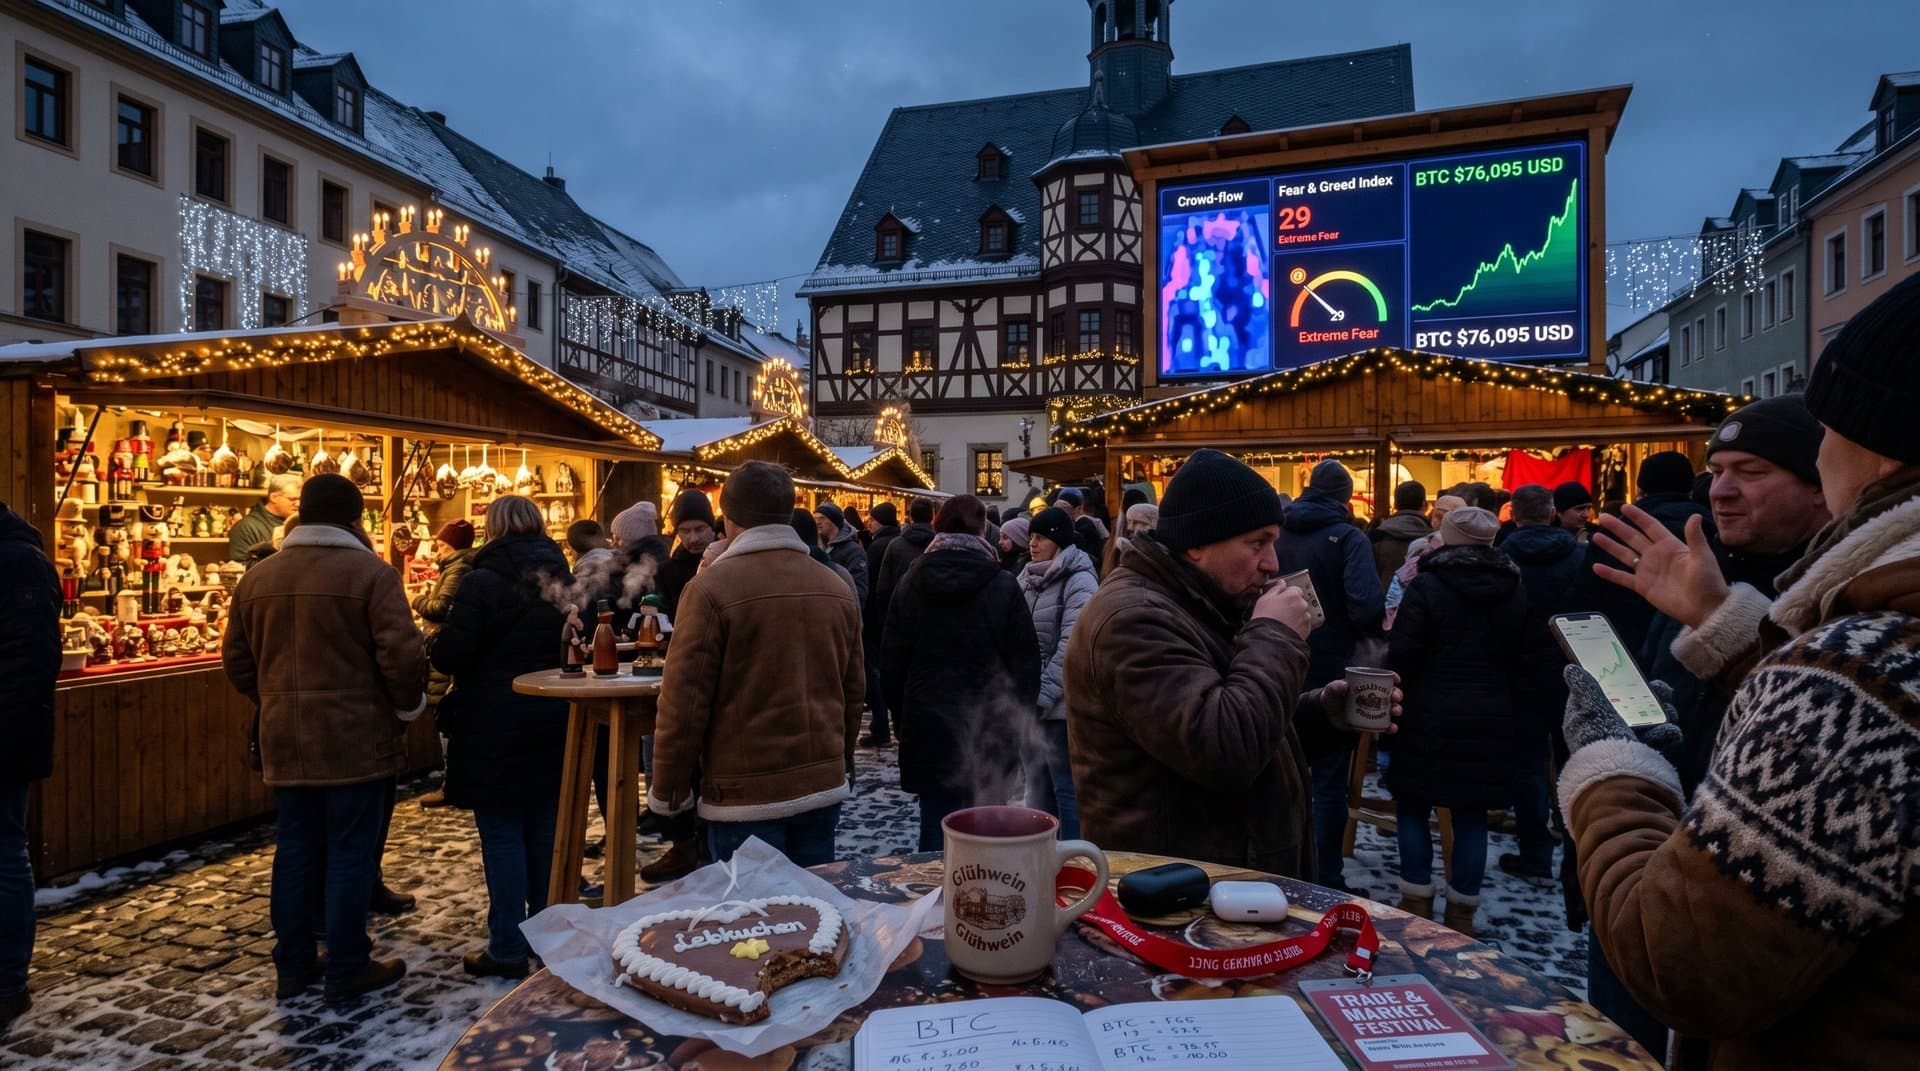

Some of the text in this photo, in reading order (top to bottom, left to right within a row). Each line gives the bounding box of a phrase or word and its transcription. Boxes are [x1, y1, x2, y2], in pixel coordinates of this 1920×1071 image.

[1415, 157, 1563, 186] BTC $76,095 USD
[1279, 175, 1393, 197] Fear & Greed Index
[1177, 191, 1244, 207] Crowd-flow
[1279, 205, 1312, 230] 29
[1330, 310, 1345, 321] 29
[1299, 328, 1380, 343] Extreme Fear
[1415, 324, 1574, 348] BTC $76,095 USD
[952, 864, 1026, 892] Glühwein
[955, 922, 1024, 951] Glühwein
[1329, 990, 1426, 1008] TRADE &
[1341, 1003, 1435, 1022] MARKET
[916, 1012, 997, 1040] BTC
[1102, 1018, 1139, 1032] BTC
[1351, 1017, 1452, 1036] FESTIVAL
[1113, 1043, 1156, 1058] BTC
